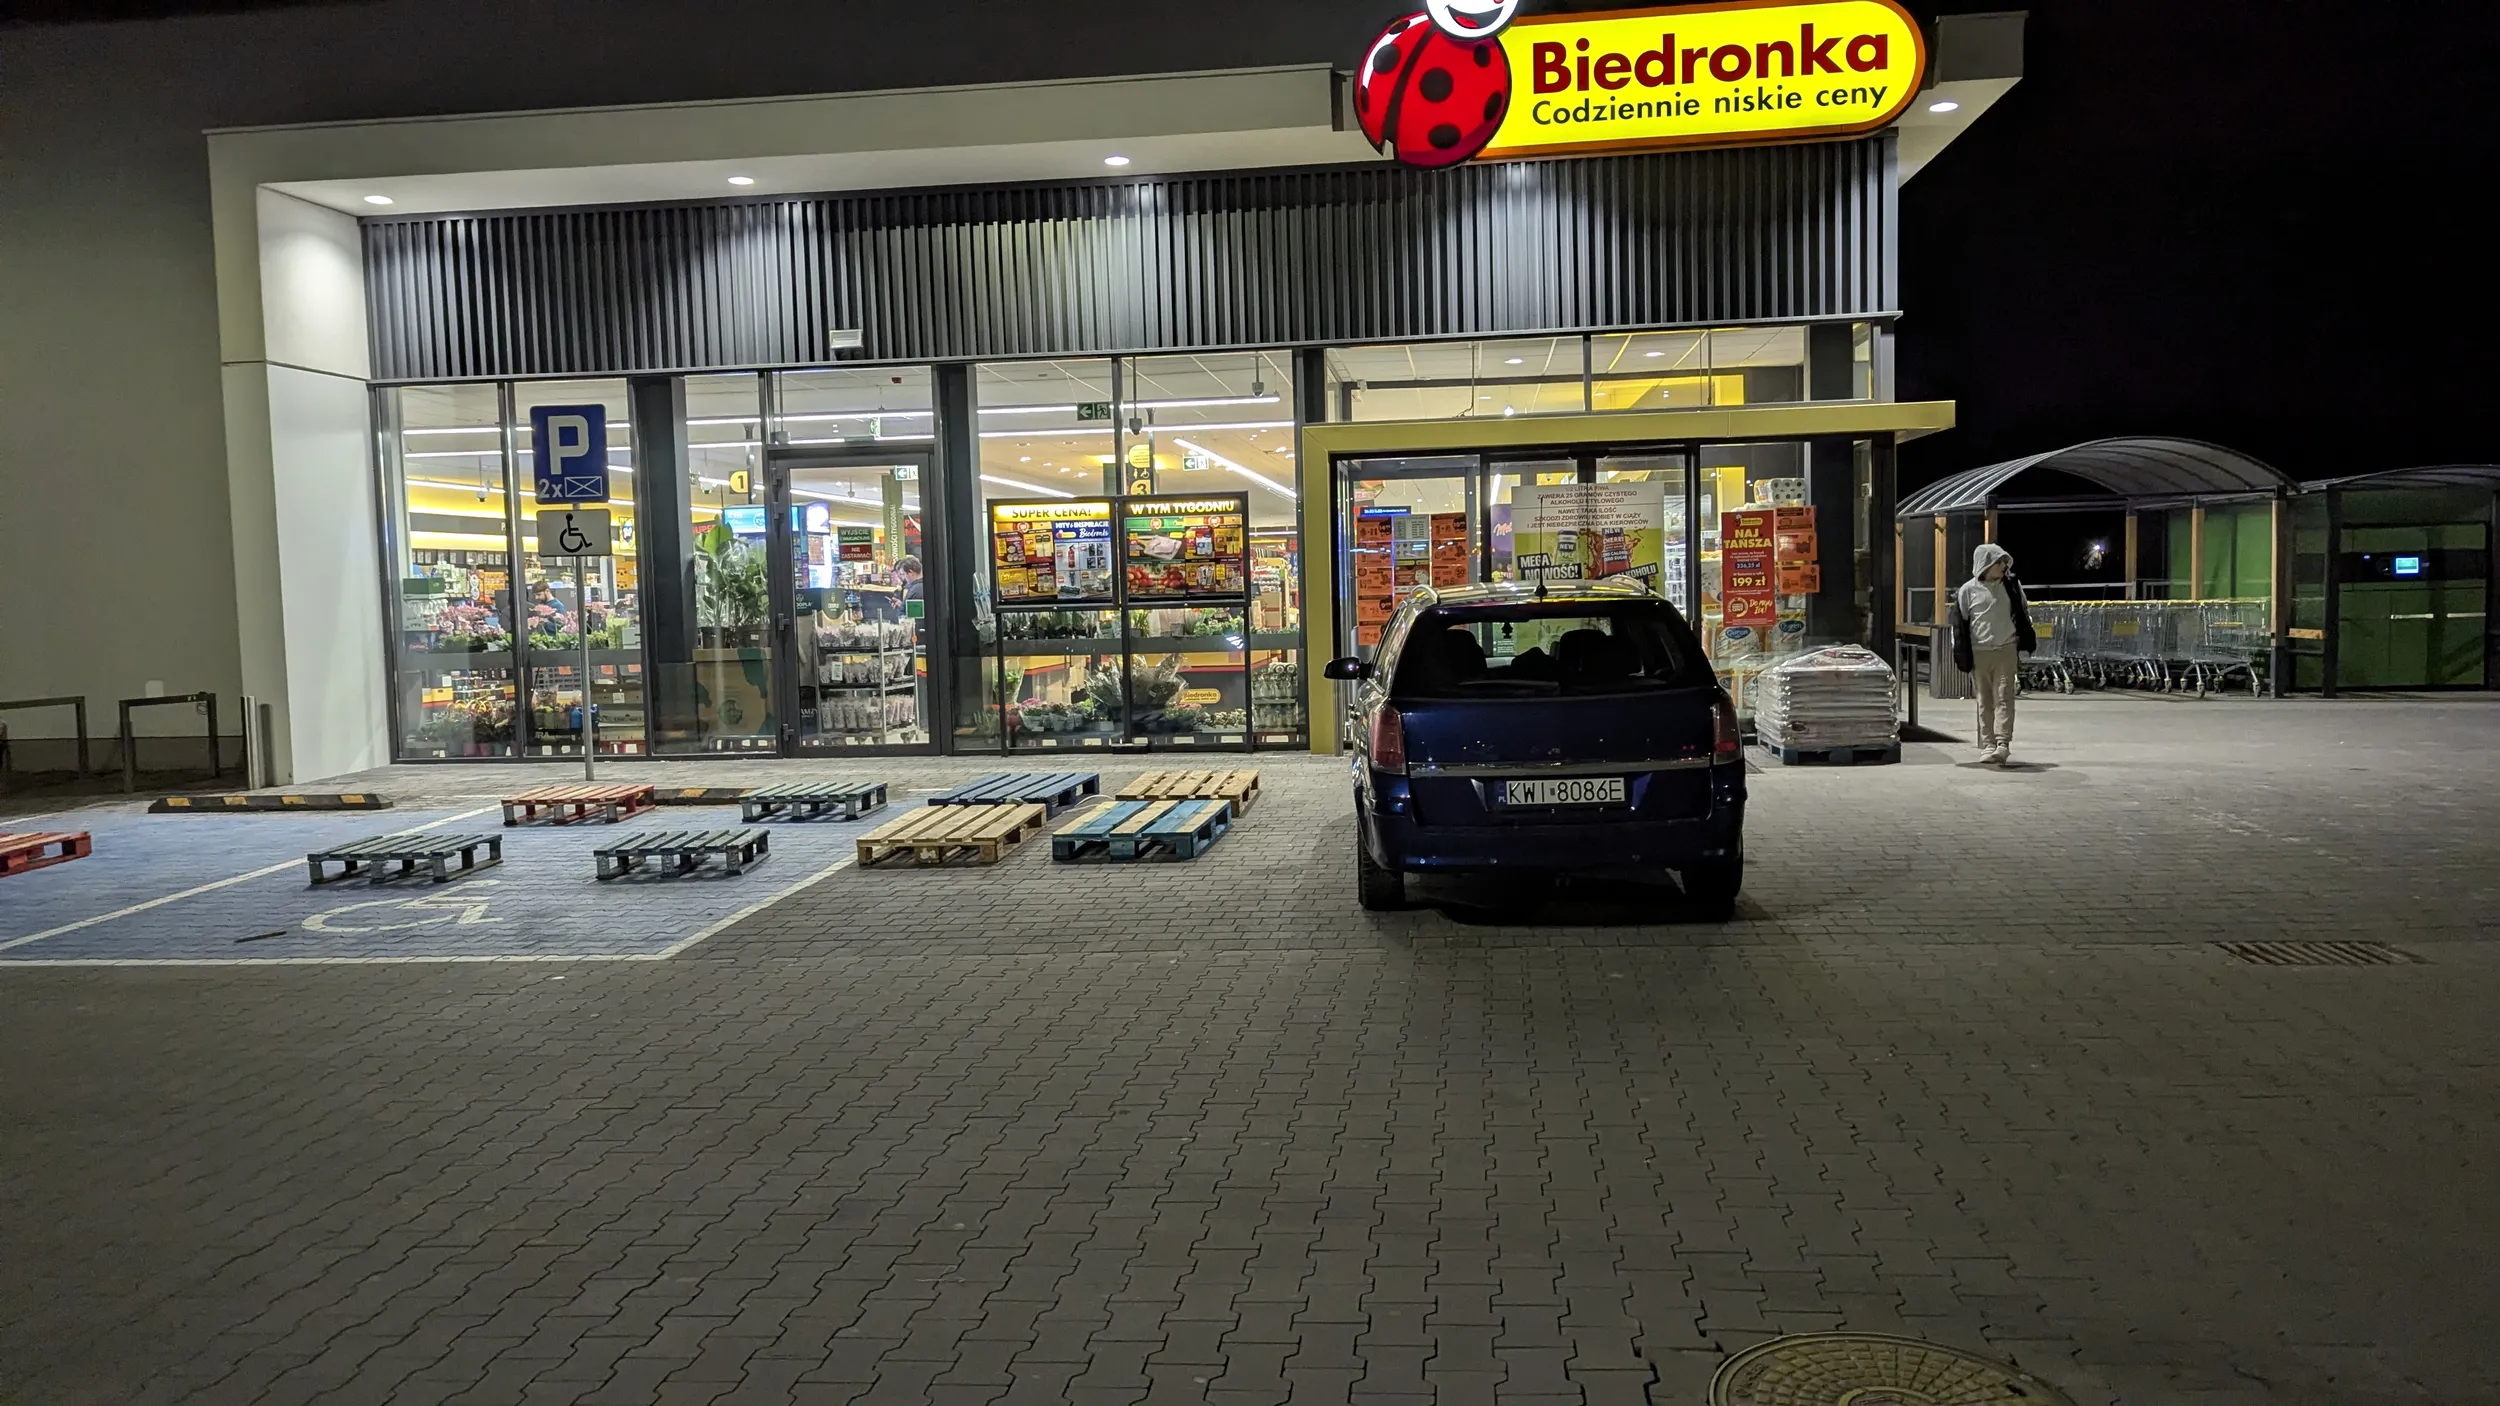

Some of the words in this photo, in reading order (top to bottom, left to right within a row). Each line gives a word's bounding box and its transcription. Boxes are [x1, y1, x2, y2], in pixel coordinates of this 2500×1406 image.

[1532, 22, 1889, 95] Biedronka
[1532, 91, 1701, 126] Codziennie
[1714, 84, 1802, 115] niskie
[1817, 82, 1889, 109] ceny
[547, 414, 590, 475] P
[538, 478, 564, 499] 2x
[737, 475, 745, 489] 1
[1537, 492, 1565, 500] ZAWIERA
[1012, 507, 1051, 519] SUPER
[1054, 506, 1092, 518] CENA!
[1130, 503, 1145, 515] W
[1146, 502, 1171, 514] TYM
[1173, 500, 1235, 513] TYGODNIU
[1598, 506, 1617, 514] ILOŚĆ
[1561, 513, 1591, 521] ZDROWIU
[1609, 518, 1649, 526] KIEROWCÓW
[840, 528, 869, 536] WYJŚCIE
[1734, 528, 1760, 539] NAJ
[1723, 537, 1773, 549] TAŃSZA
[1520, 554, 1551, 569] MEGA
[1524, 562, 1579, 581] NOWOŚĆ!
[1732, 576, 1753, 587] 199
[1755, 575, 1767, 586] zł
[1508, 782, 1545, 803] KWI
[1557, 780, 1622, 802] 8086E
